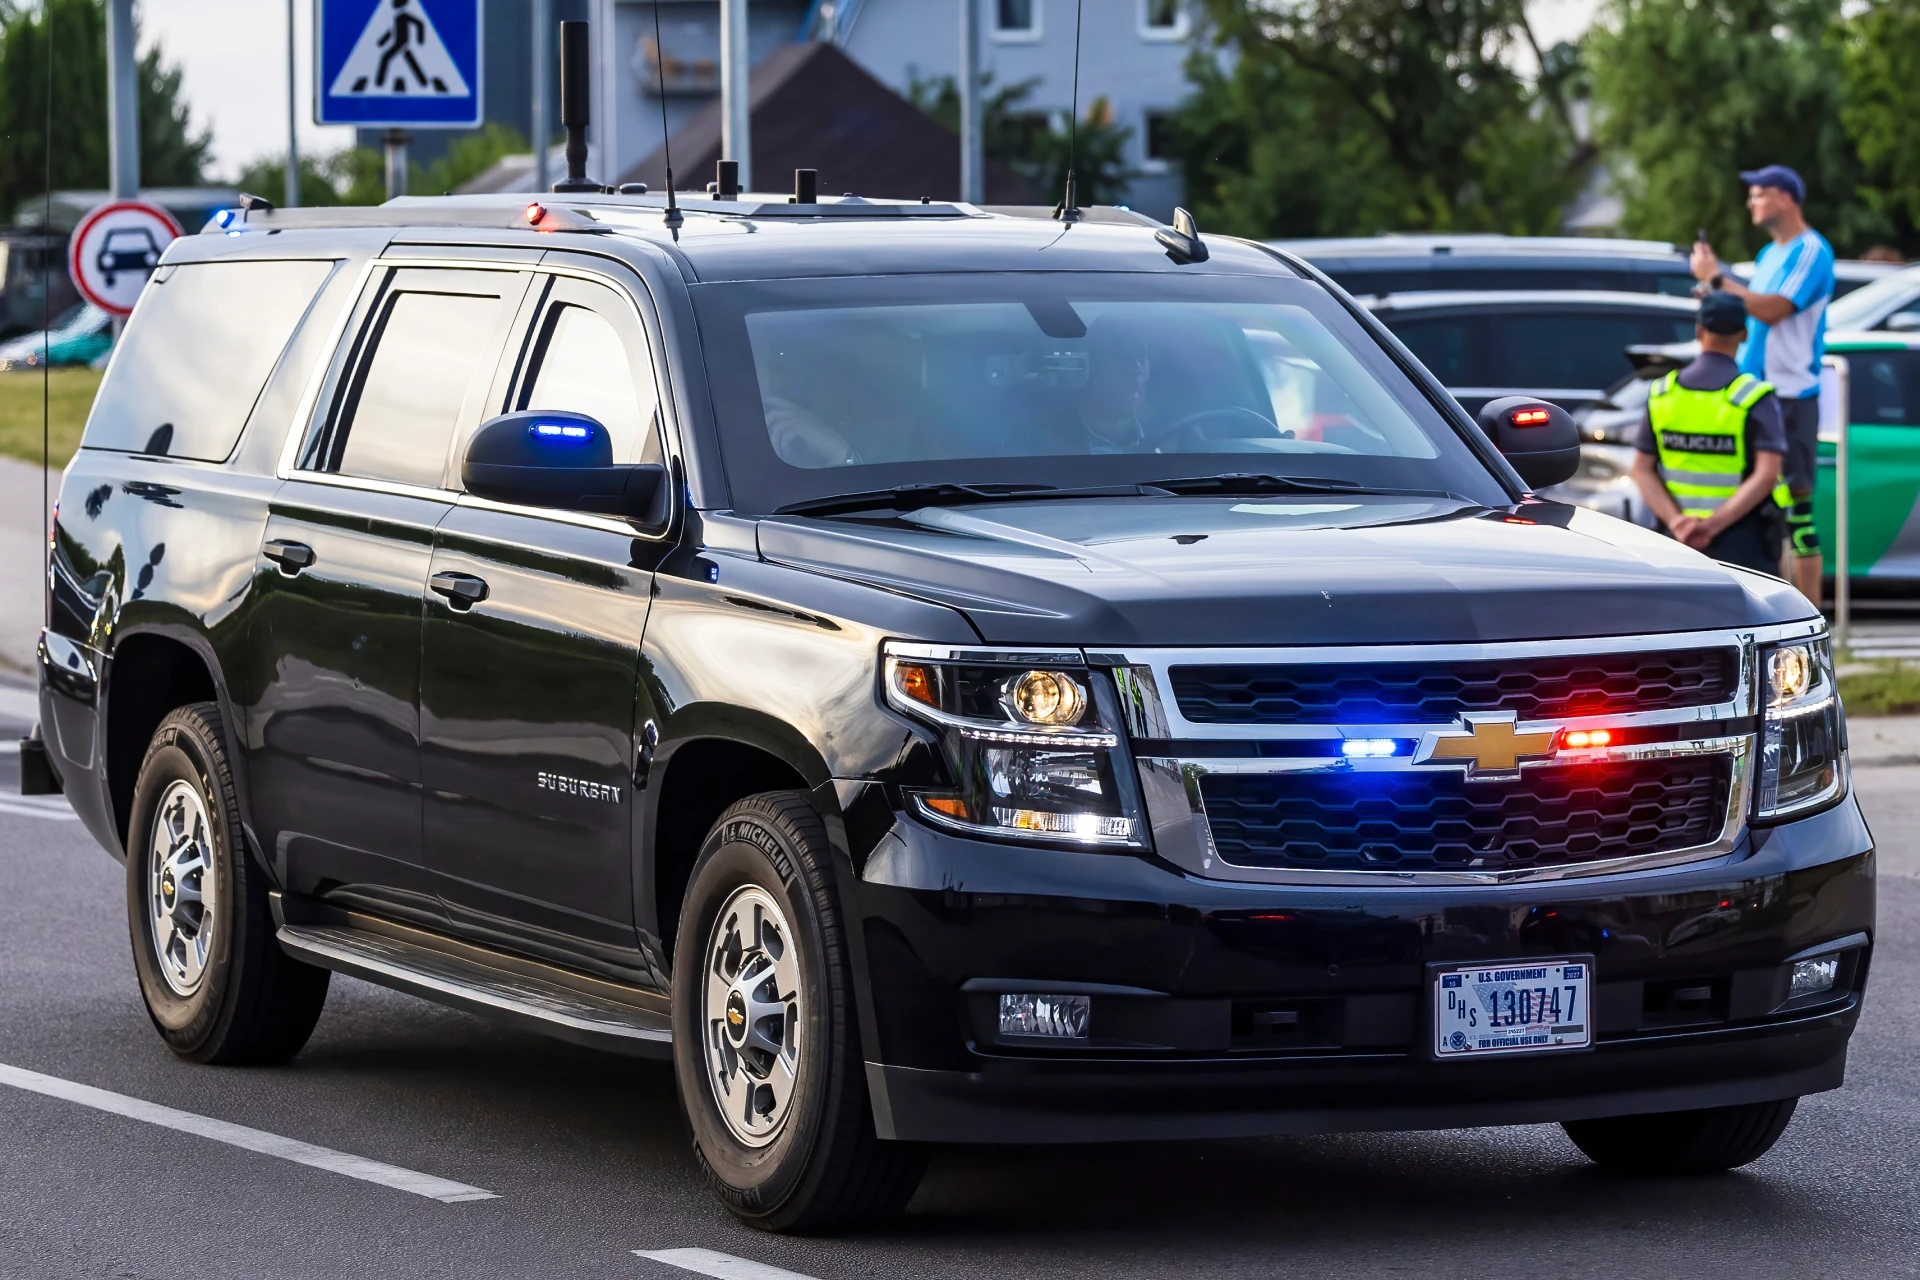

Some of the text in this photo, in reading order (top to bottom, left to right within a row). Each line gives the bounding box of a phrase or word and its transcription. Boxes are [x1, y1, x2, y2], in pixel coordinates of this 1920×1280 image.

[1663, 434, 1734, 450] POLICIJA
[537, 771, 621, 803] SUBURBAN
[737, 823, 795, 877] MICHELIN
[1478, 968, 1547, 983] U.S. GOVERNMENT
[1489, 985, 1577, 1028] 130747
[1442, 1036, 1448, 1047] A
[1478, 1039, 1491, 1048] FOR
[1492, 1037, 1520, 1047] OFFICIAL
[1520, 1036, 1532, 1045] USE
[1533, 1035, 1549, 1044] ONLY
